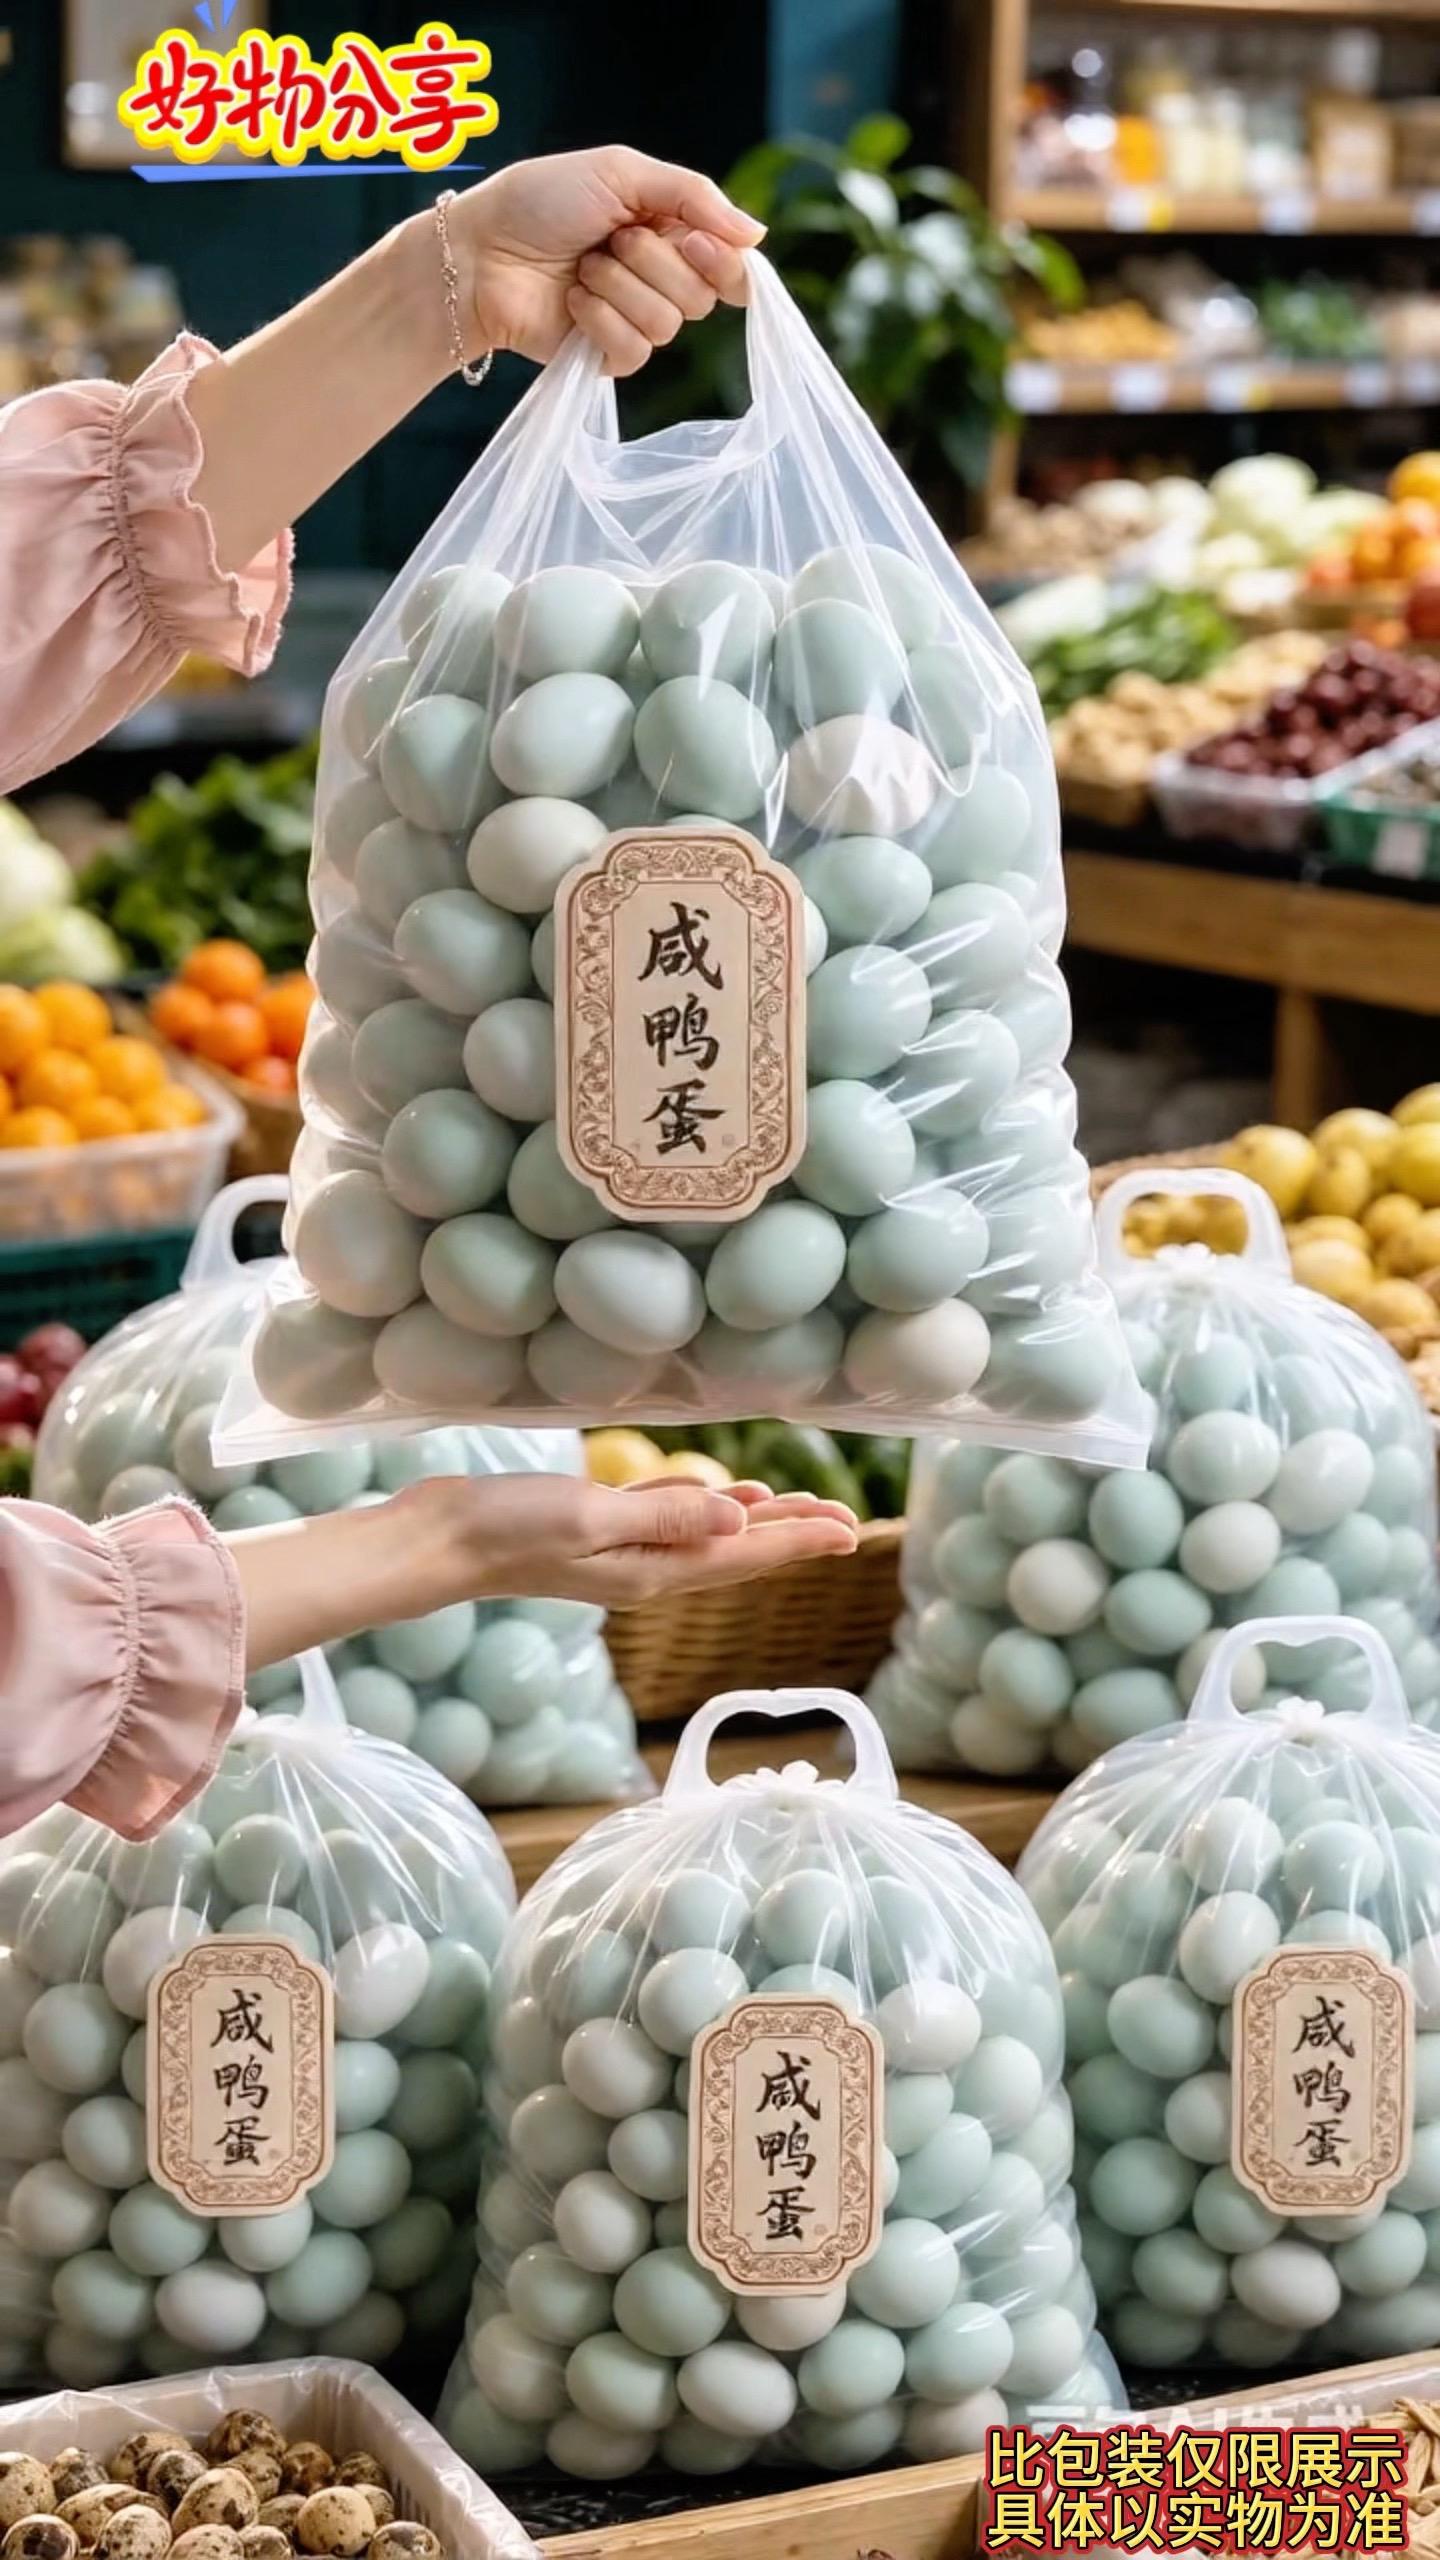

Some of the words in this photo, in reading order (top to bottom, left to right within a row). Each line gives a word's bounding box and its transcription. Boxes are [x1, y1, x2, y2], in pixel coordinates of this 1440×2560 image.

[637, 901, 726, 1155] 咸鸭蛋
[210, 1988, 274, 2166] 咸鸭蛋
[755, 2050, 822, 2242] 咸鸭蛋
[1292, 1996, 1356, 2167] 咸鸭蛋
